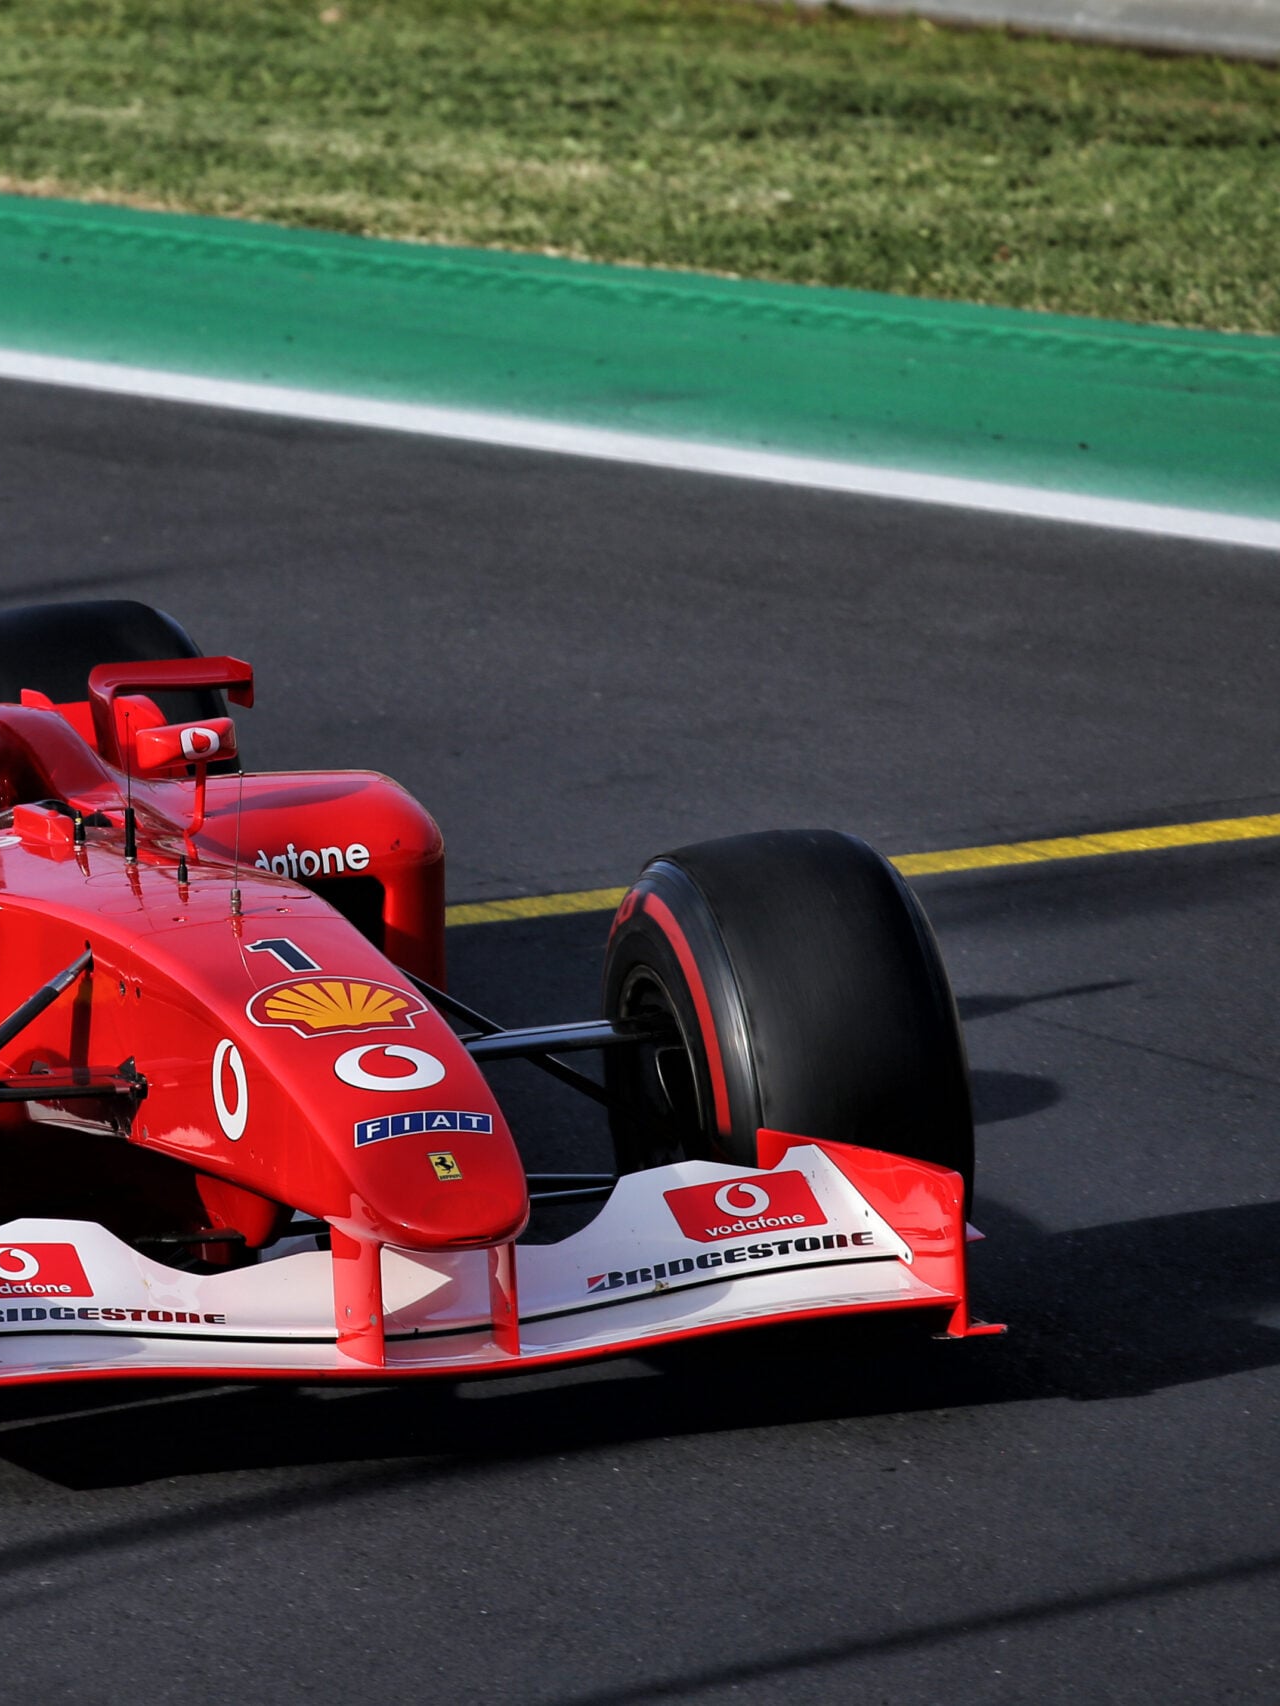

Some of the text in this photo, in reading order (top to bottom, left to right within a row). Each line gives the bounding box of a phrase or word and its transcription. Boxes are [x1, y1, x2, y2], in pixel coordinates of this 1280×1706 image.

[255, 843, 370, 878] dafone
[244, 938, 322, 973] 1
[363, 1113, 486, 1142] FIAT
[705, 1212, 807, 1238] vodafone
[587, 1231, 874, 1294] BRIDGESTONE
